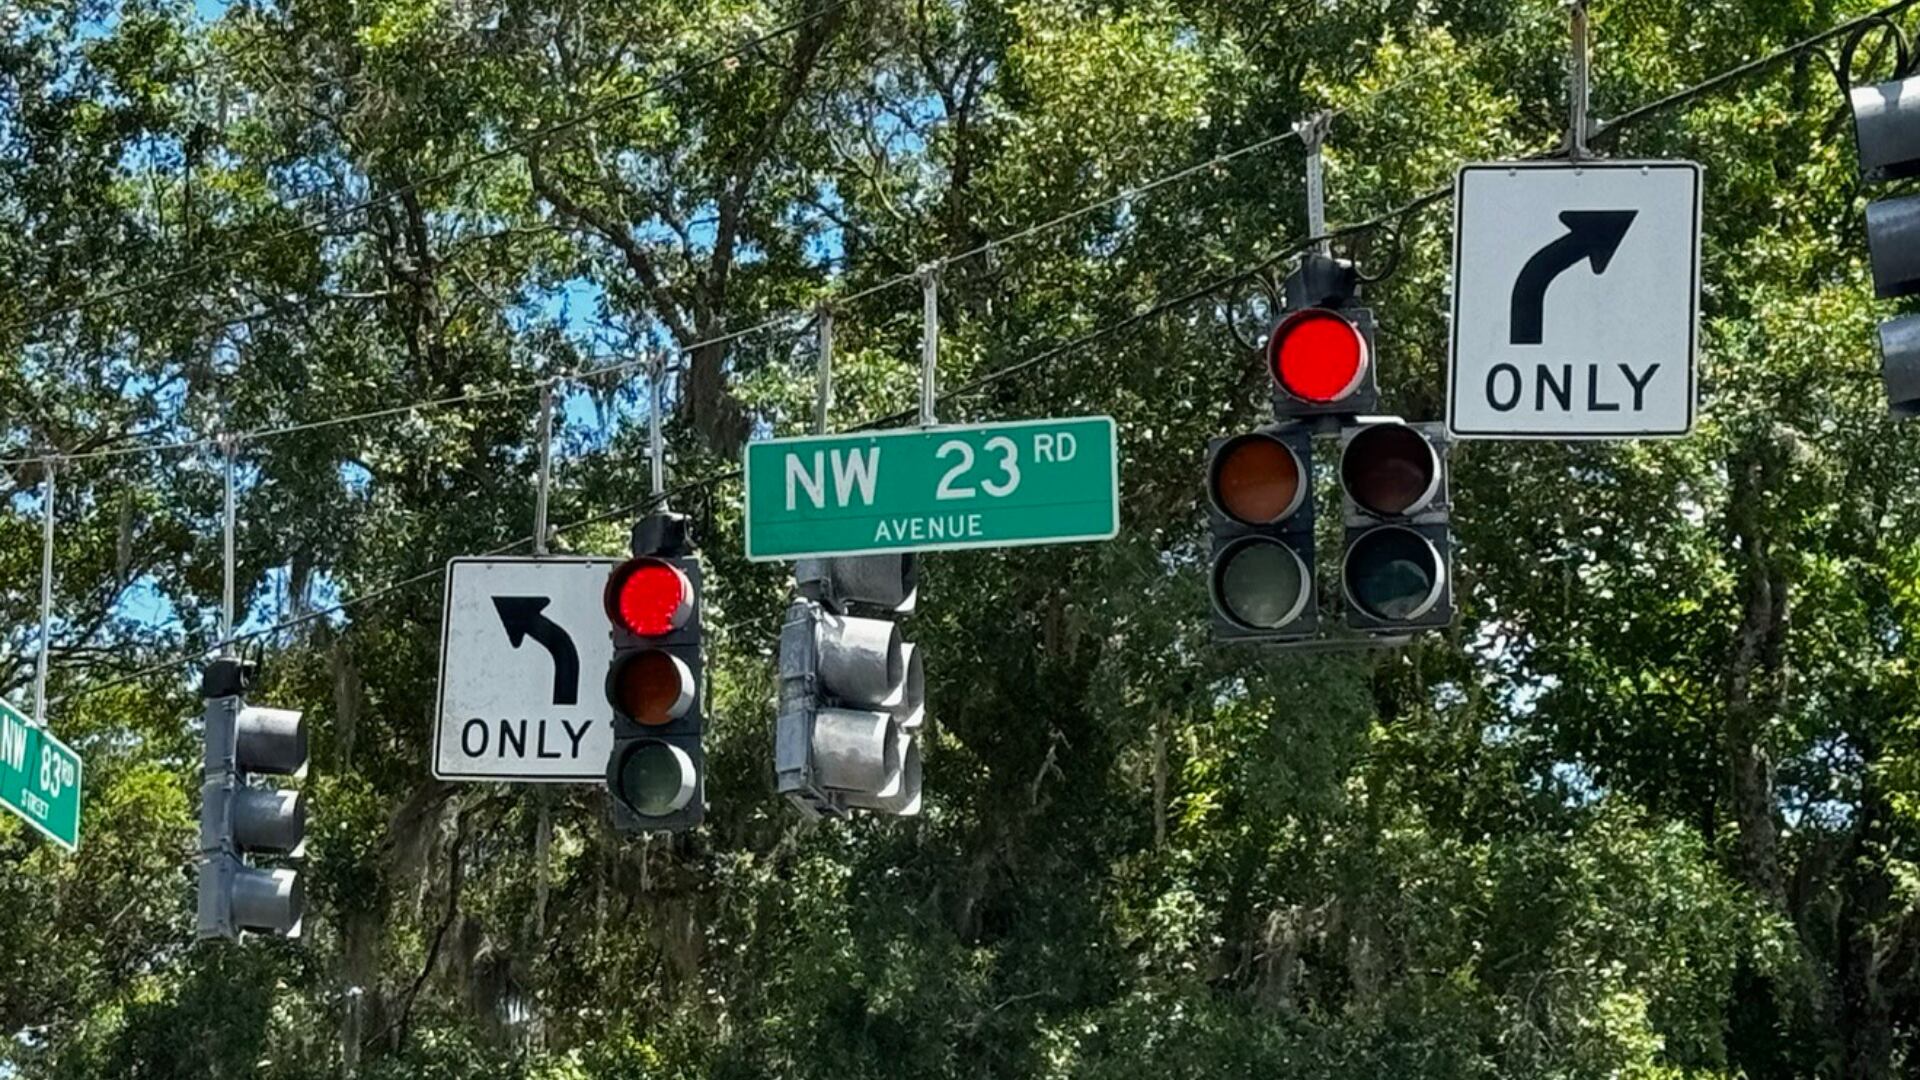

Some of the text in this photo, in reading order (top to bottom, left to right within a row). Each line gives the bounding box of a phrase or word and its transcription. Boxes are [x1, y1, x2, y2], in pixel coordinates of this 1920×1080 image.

[1486, 362, 1661, 412] ONLY
[785, 447, 880, 511] NW
[874, 514, 983, 542] AVENUE
[0, 714, 27, 773] NW
[461, 718, 592, 759] ONLY
